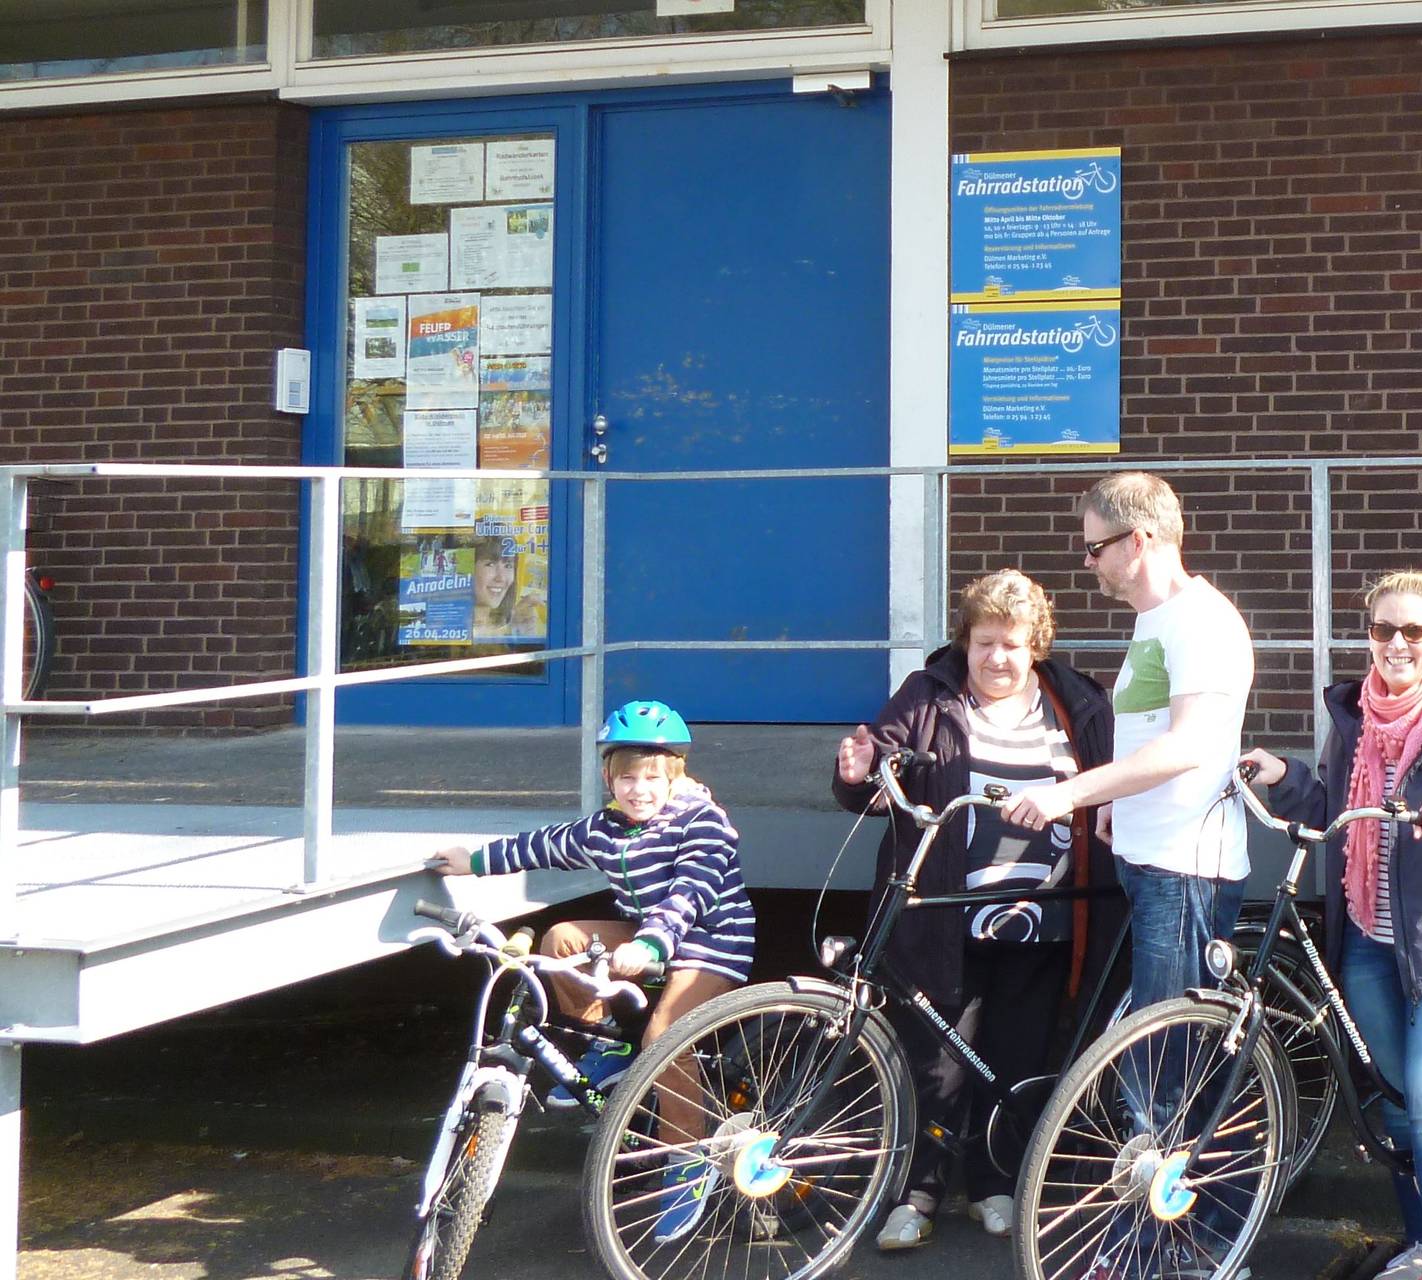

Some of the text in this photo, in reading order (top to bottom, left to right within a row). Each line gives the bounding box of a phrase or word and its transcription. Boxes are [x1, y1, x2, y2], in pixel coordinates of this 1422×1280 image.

[984, 172, 1016, 180] Dülmener
[957, 175, 1083, 197] Fahrradstation
[1000, 216, 1015, 224] April
[983, 323, 1016, 331] Dülmener
[957, 328, 1082, 347] Fahrradstation
[502, 538, 516, 557] 2
[407, 574, 471, 595] Anradeln!
[405, 628, 468, 640] 26.04.2015
[1302, 939, 1371, 1063] Dülmener Fahrradstation
[947, 1027, 996, 1082] Fahrradstation
